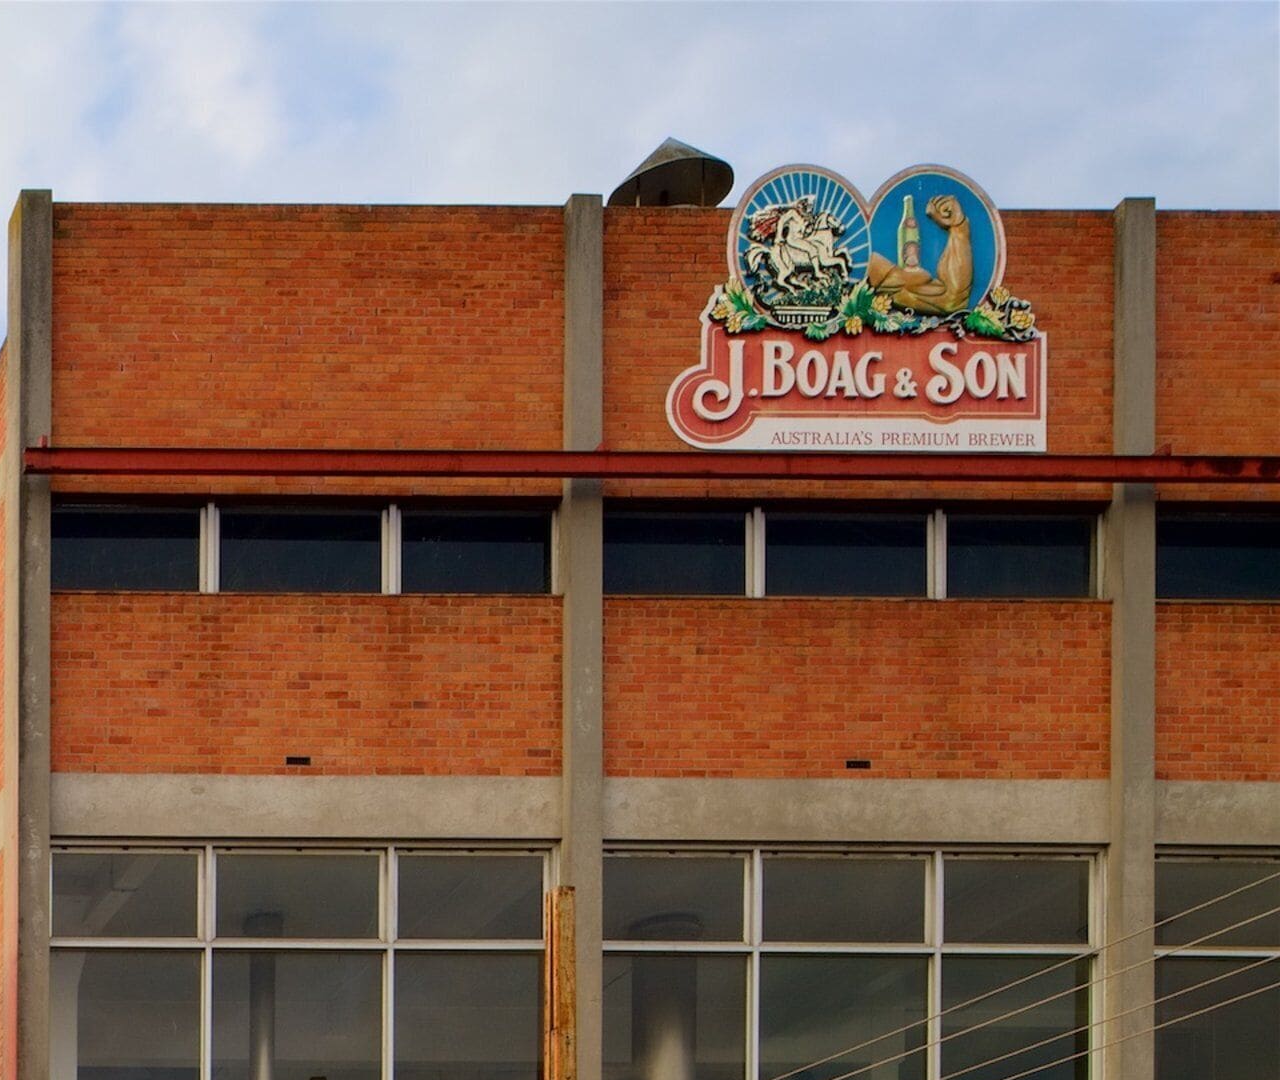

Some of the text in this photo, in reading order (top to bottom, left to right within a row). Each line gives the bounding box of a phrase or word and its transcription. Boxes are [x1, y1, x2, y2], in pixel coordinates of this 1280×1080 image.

[893, 367, 918, 398] &
[925, 341, 1027, 404] SON
[771, 430, 1036, 447] AUSTRALIA'S PREMIUM BREWER
